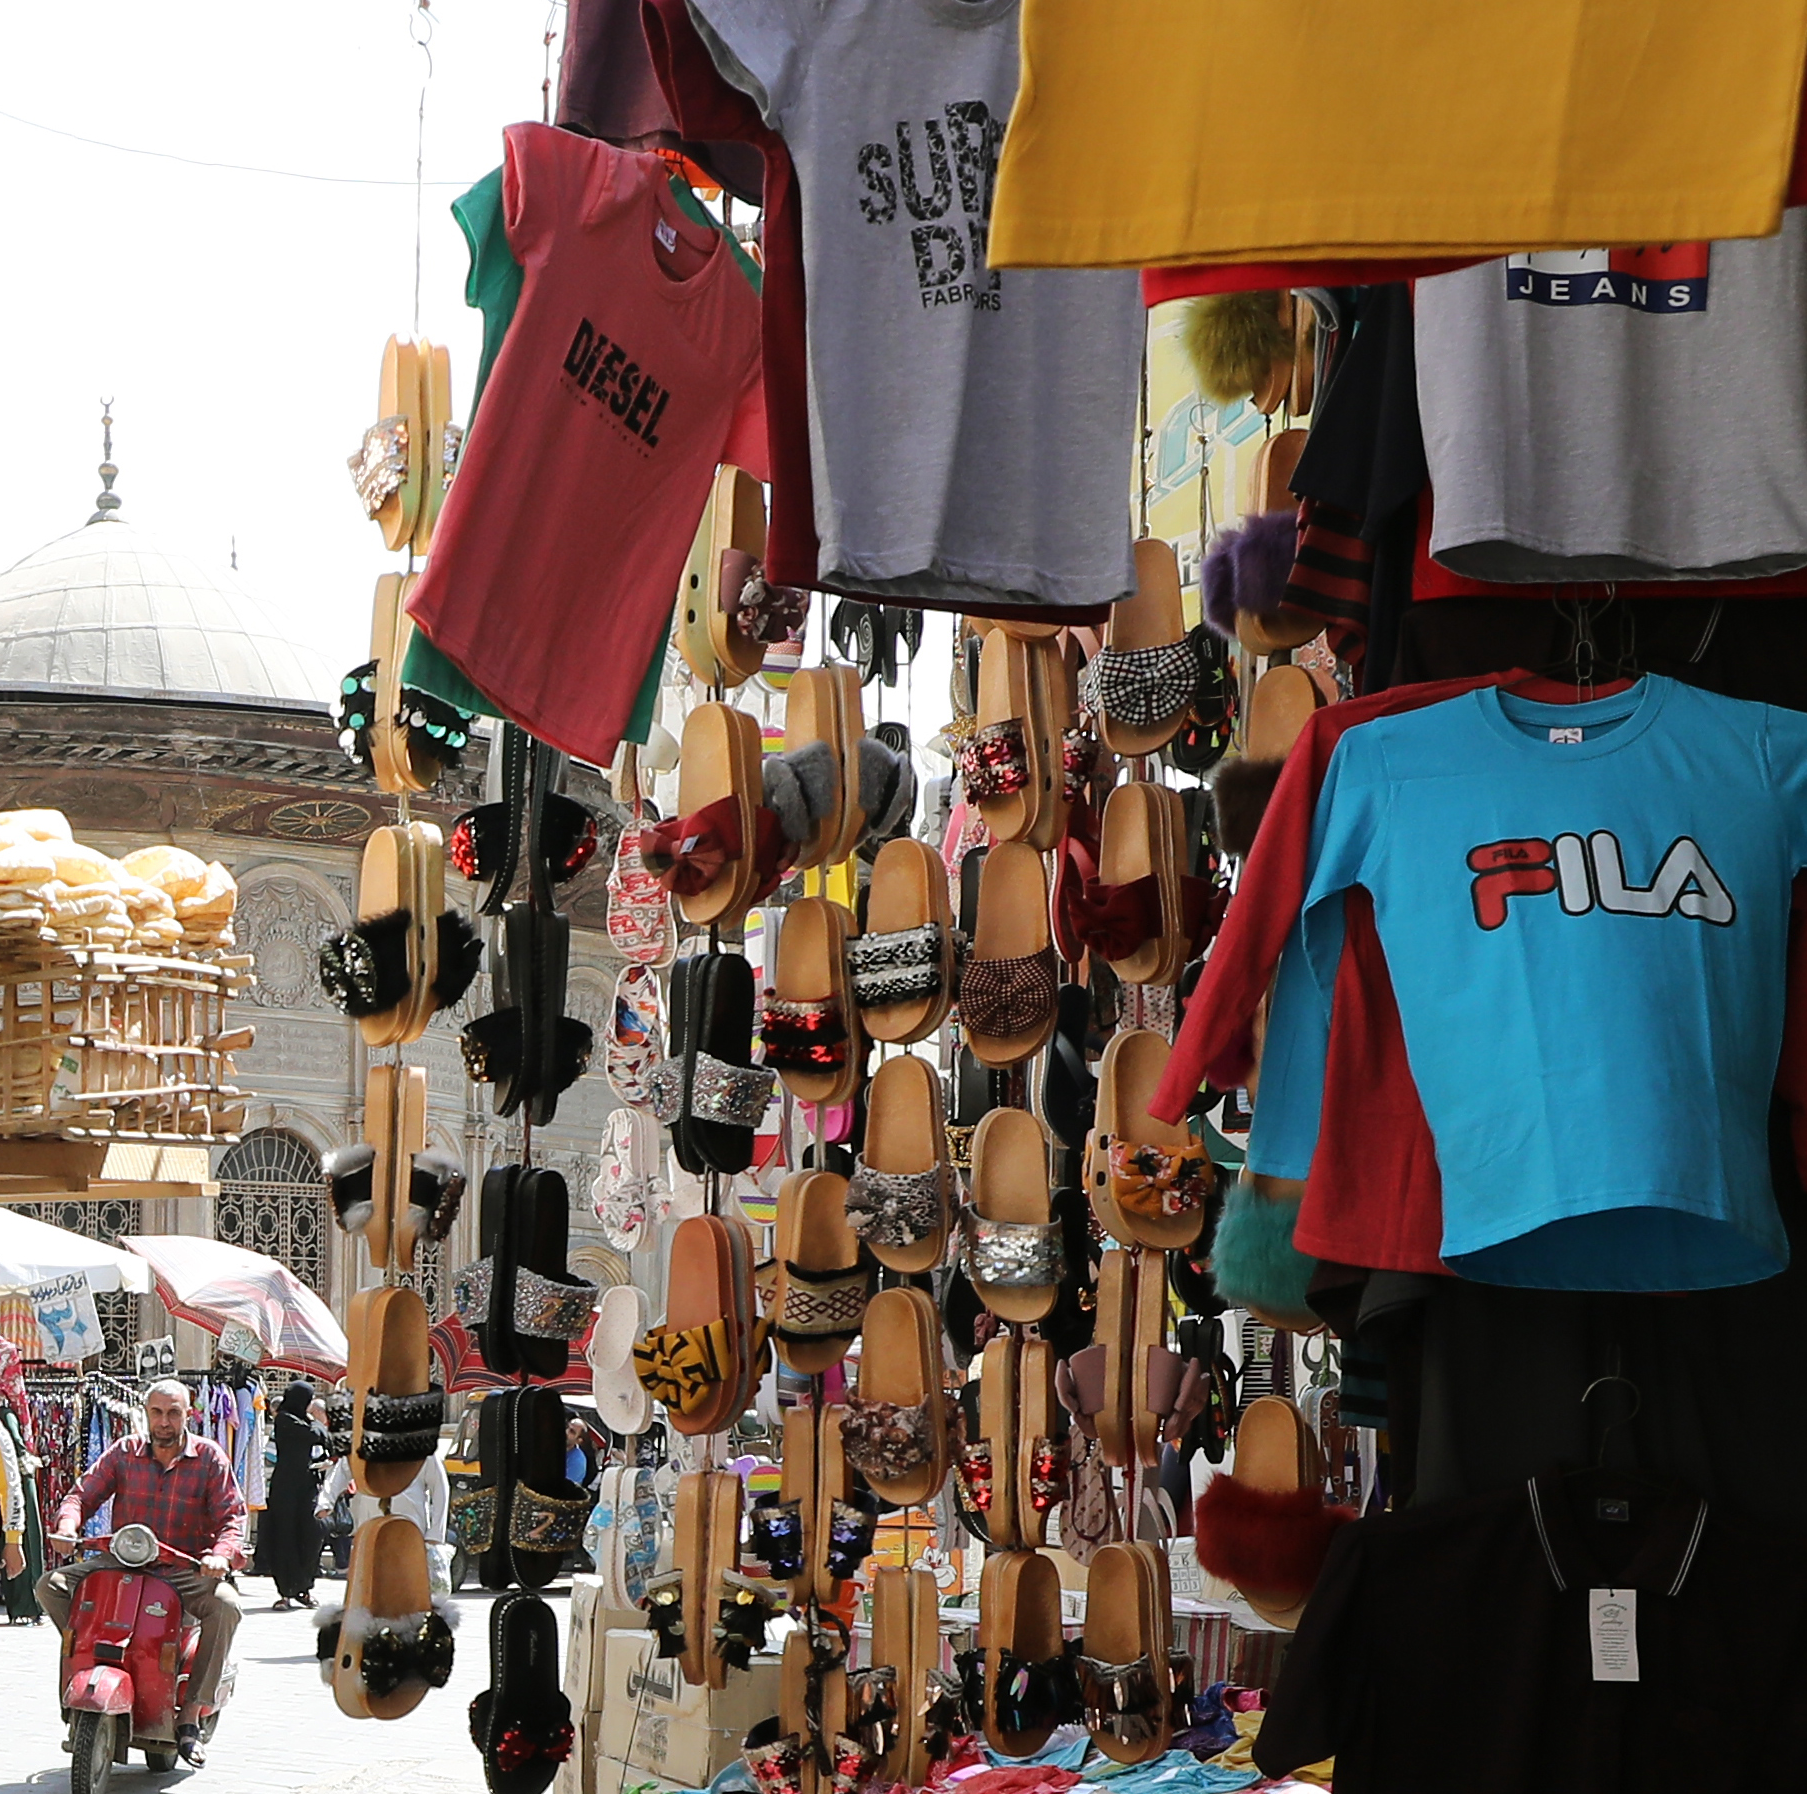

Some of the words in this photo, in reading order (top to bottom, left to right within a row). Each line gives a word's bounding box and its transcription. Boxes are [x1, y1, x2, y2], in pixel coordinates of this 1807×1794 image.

[1519, 275, 1691, 307] JEANS
[563, 317, 671, 449] DIESEL
[1466, 830, 1737, 931] FILA
[1492, 848, 1529, 861] FILA
